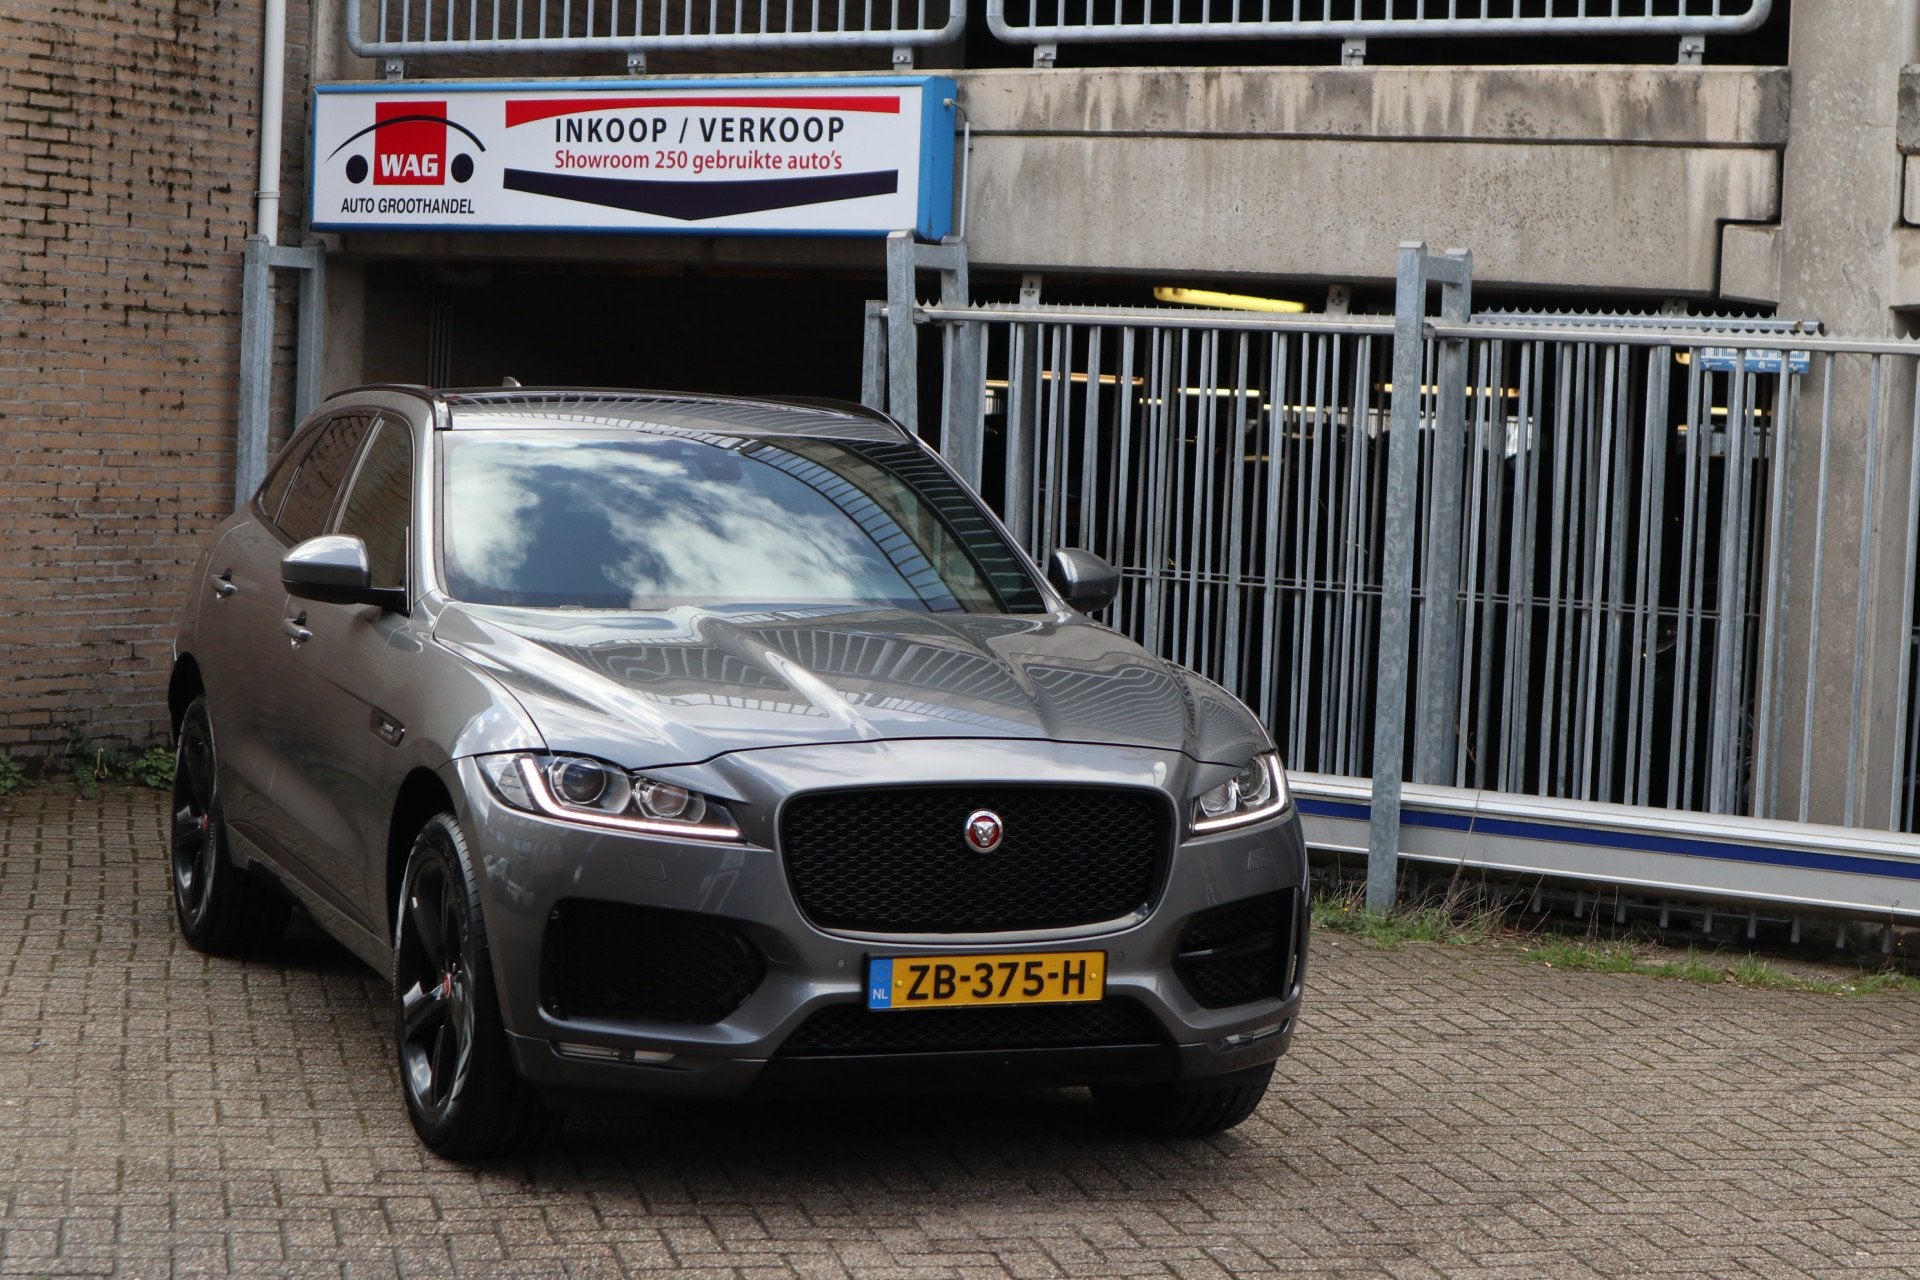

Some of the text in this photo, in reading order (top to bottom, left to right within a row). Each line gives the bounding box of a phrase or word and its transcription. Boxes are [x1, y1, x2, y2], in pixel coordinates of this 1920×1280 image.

[555, 116, 845, 143] INKOOP / VERKOOP
[380, 153, 438, 177] WAG
[555, 149, 843, 174] Showroom 250 gebruikte auto's
[340, 197, 476, 214] AUTO GROOTHANDEL
[906, 959, 1087, 1002] ZB-375-H
[872, 988, 889, 1001] NL
